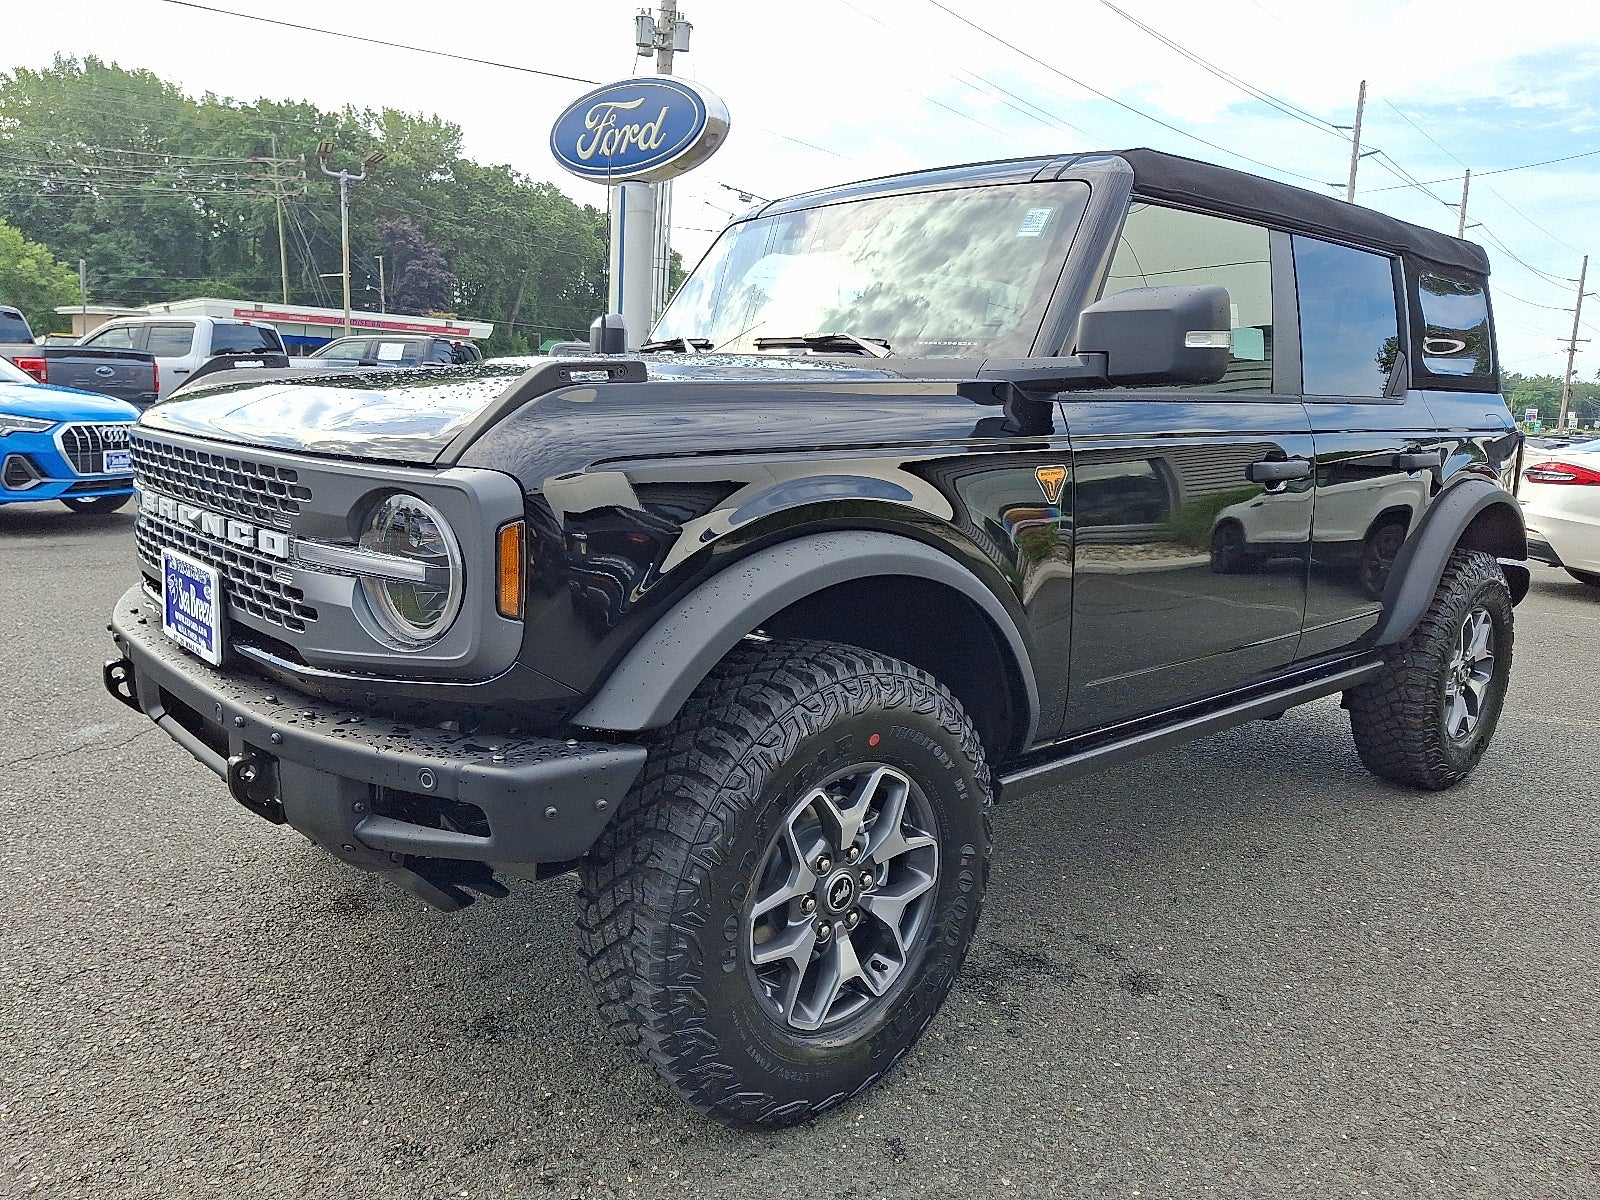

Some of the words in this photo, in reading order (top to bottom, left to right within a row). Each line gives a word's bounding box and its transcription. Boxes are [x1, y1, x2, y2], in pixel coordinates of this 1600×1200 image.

[576, 97, 670, 161] Ford
[178, 577, 190, 615] Sea
[189, 583, 213, 627] Breeze
